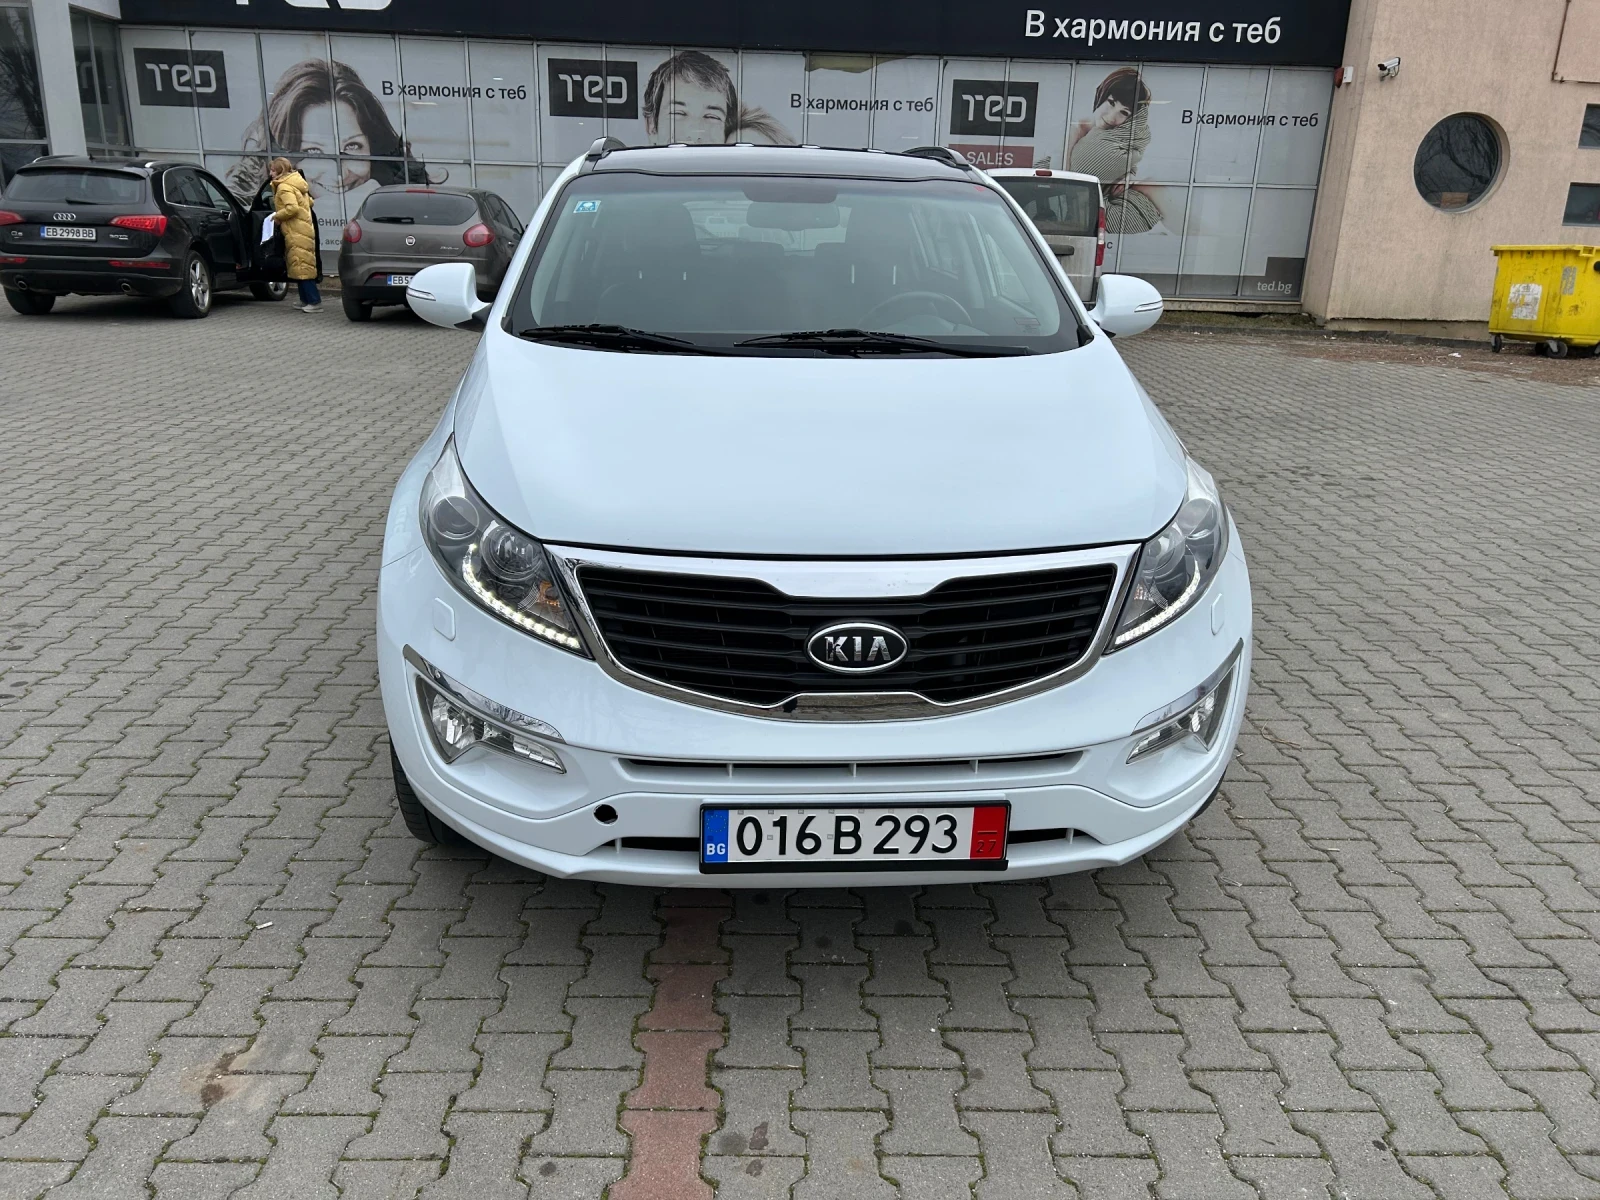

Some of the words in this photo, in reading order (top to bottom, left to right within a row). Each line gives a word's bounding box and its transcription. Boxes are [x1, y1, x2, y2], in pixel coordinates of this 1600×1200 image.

[1025, 9, 1045, 37] В
[1053, 17, 1201, 46] хармония
[1209, 21, 1225, 42] с
[1232, 16, 1281, 44] теб
[381, 80, 394, 96] В
[398, 84, 481, 100] хармония
[485, 87, 495, 98] с
[498, 85, 527, 100] теб
[790, 93, 802, 108] В
[806, 97, 889, 114] хармония
[893, 100, 902, 111] с
[906, 97, 934, 112] теб
[1181, 110, 1193, 124] В
[1196, 113, 1275, 128] хармония
[1279, 117, 1289, 126] с
[1292, 113, 1319, 127] теб
[966, 151, 1014, 166] SALES
[1257, 280, 1293, 294] ted.bg
[824, 636, 892, 661] KIA
[706, 843, 726, 855] BG
[976, 840, 997, 853] 27
